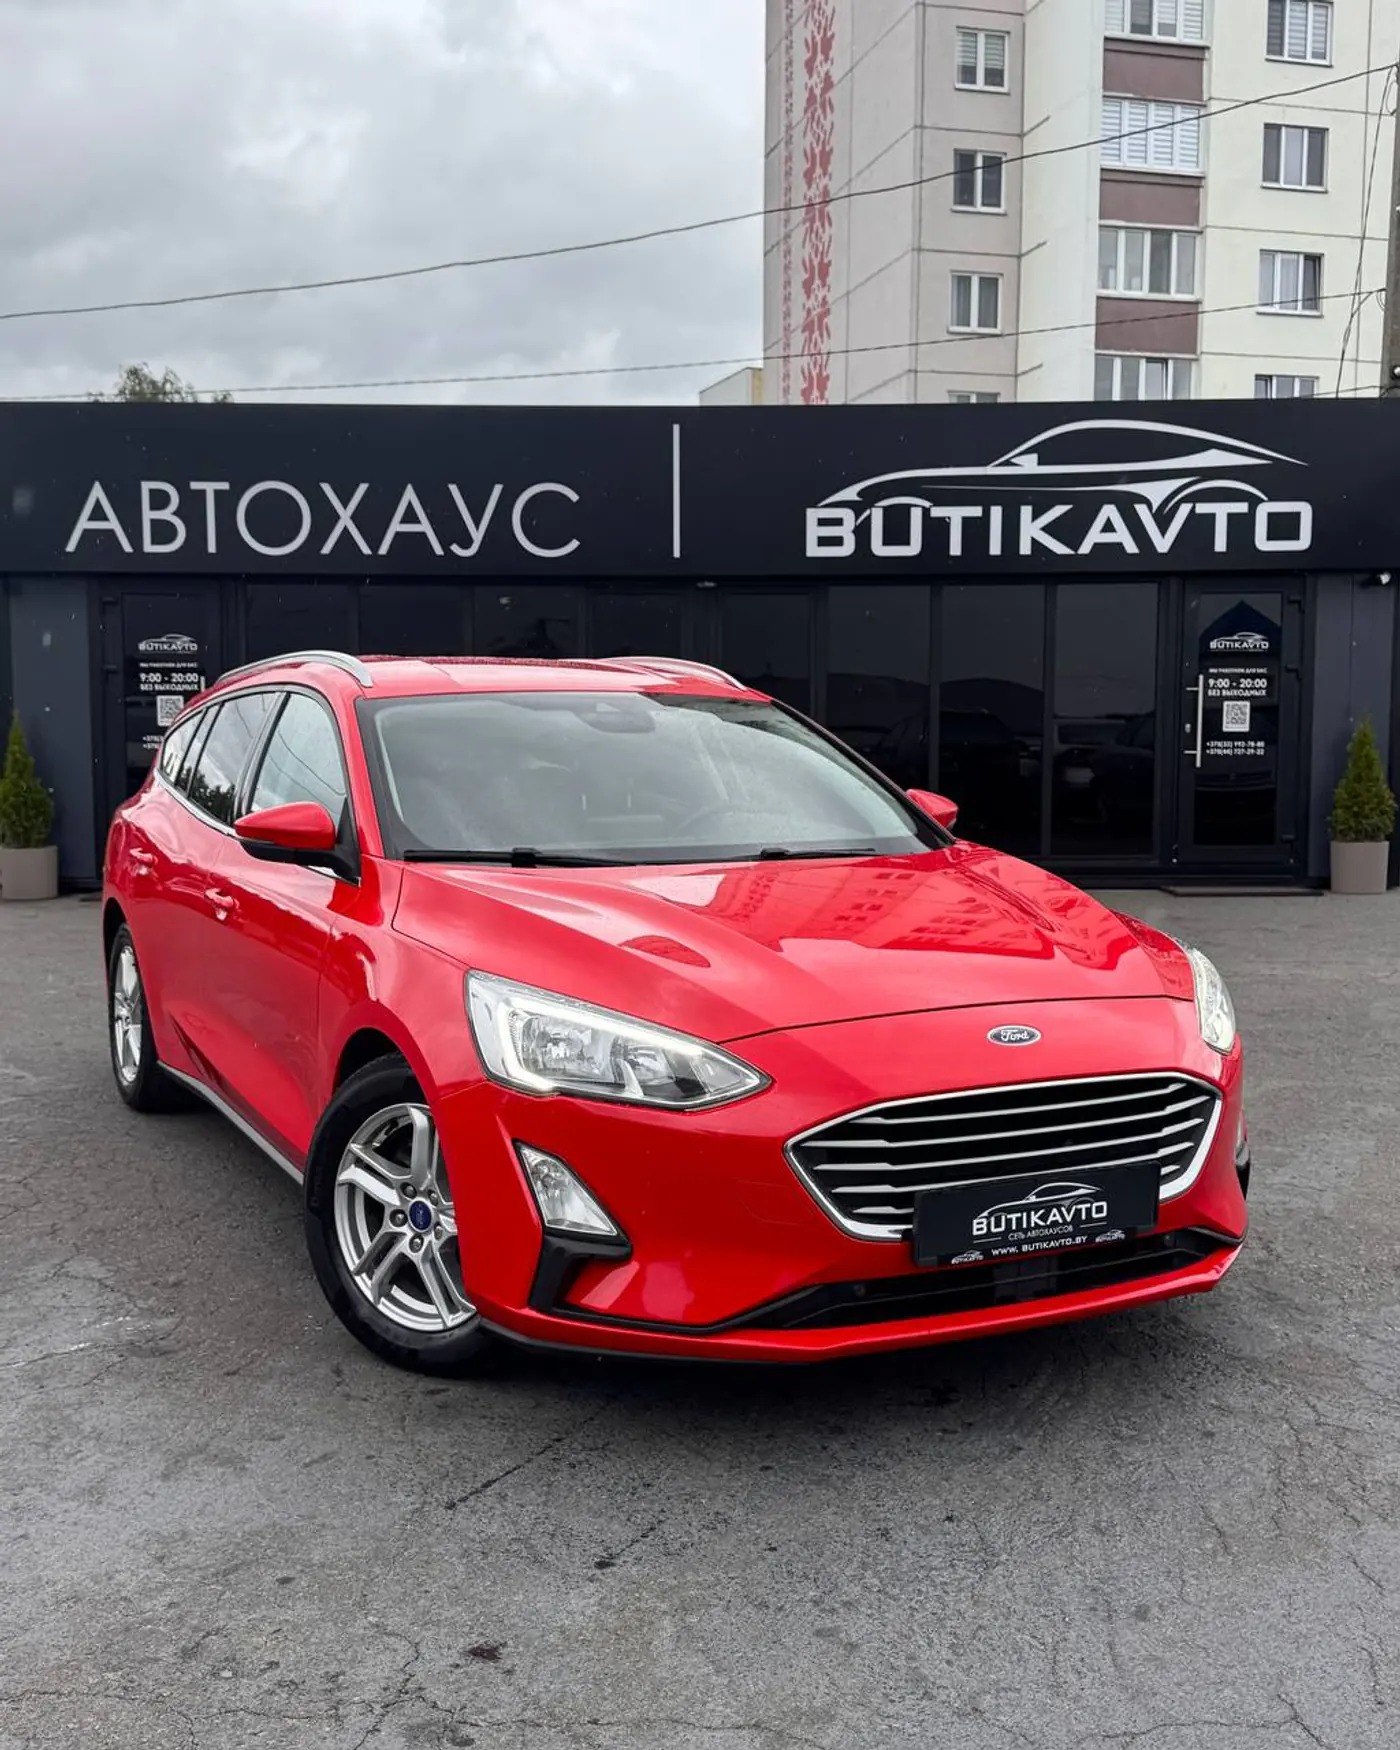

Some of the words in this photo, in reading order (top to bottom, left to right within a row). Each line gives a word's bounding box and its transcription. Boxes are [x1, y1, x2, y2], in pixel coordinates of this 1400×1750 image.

[65, 480, 581, 558] АВТОХАУС
[804, 499, 1313, 558] BUTIKAVTO
[1209, 640, 1269, 649] BUTIKAVTO
[139, 672, 162, 682] 9:00
[170, 672, 199, 682] 20:00
[1208, 678, 1230, 688] 9:00
[1239, 678, 1267, 688] 20:00
[1221, 689, 1267, 697] ВЫХОДНЫХ
[1000, 1029, 1030, 1041] Ford
[972, 1201, 1107, 1236] BUTIKAVTO
